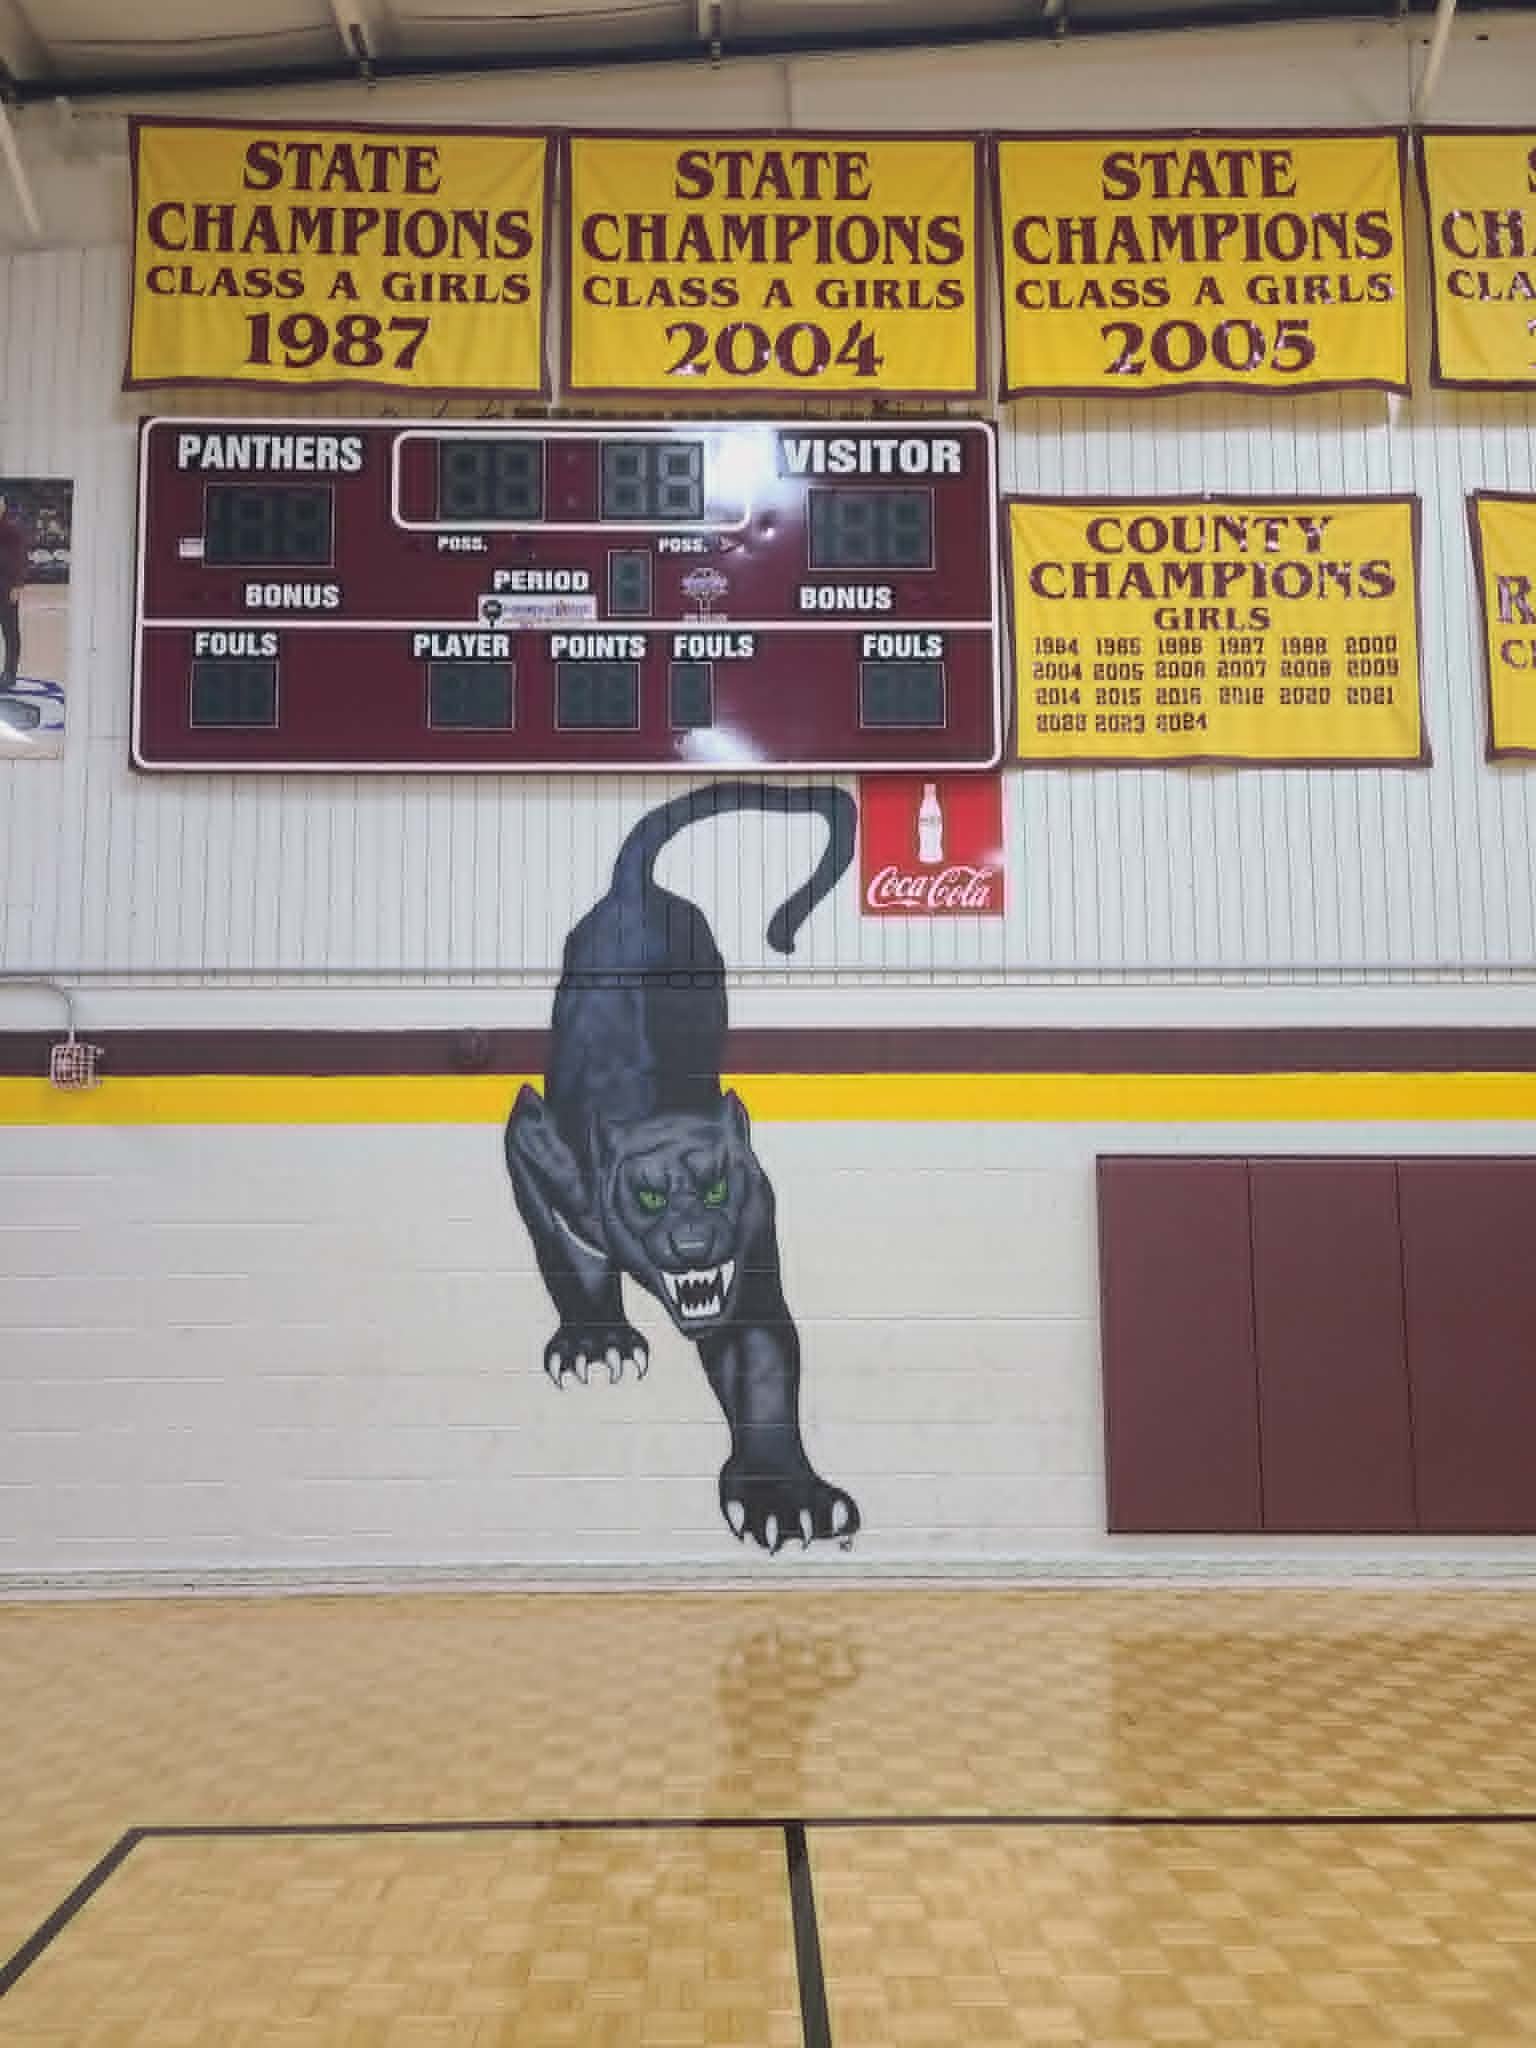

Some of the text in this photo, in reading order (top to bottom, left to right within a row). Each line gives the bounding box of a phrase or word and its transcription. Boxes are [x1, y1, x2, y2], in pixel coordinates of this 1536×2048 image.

[243, 141, 441, 194] STATE
[675, 150, 872, 200] STATE
[1102, 150, 1296, 200] STATE
[147, 202, 532, 260] CHAMPIONS
[582, 213, 964, 265] CHAMPIONS
[1013, 209, 1393, 265] CHAMPIONS
[146, 265, 531, 305] CLASS A GIRLS
[583, 276, 965, 310] CLASS A GIRLS
[1015, 272, 1394, 310] CLASS A GIRLS
[244, 312, 431, 369] 1987
[664, 320, 885, 377] 2004
[1102, 319, 1316, 375] 2005
[177, 434, 363, 472] PANTHERS
[782, 439, 962, 473] VISITOR
[437, 535, 489, 553] POSS.
[1085, 515, 1335, 554] COUNTY
[245, 584, 341, 608] BONUS
[493, 570, 590, 592] PERIOD
[799, 586, 894, 610] BONUS
[1029, 560, 1397, 600] CHAMPIONS
[1153, 606, 1272, 631] GIRLS
[194, 632, 279, 657] FOULS
[413, 633, 511, 658] PLAYER
[550, 634, 648, 658] POINTS
[672, 634, 755, 658] FOULS
[862, 634, 944, 658] FOULS
[1034, 636, 1080, 656] 1984
[1345, 634, 1397, 655] 2000
[1032, 661, 1082, 681] 2004
[1093, 662, 1145, 681] 2005
[1216, 659, 1267, 679] 2007
[1035, 687, 1081, 705] 2014
[1095, 687, 1142, 705] 2015
[867, 865, 994, 909] Coca-Cola
